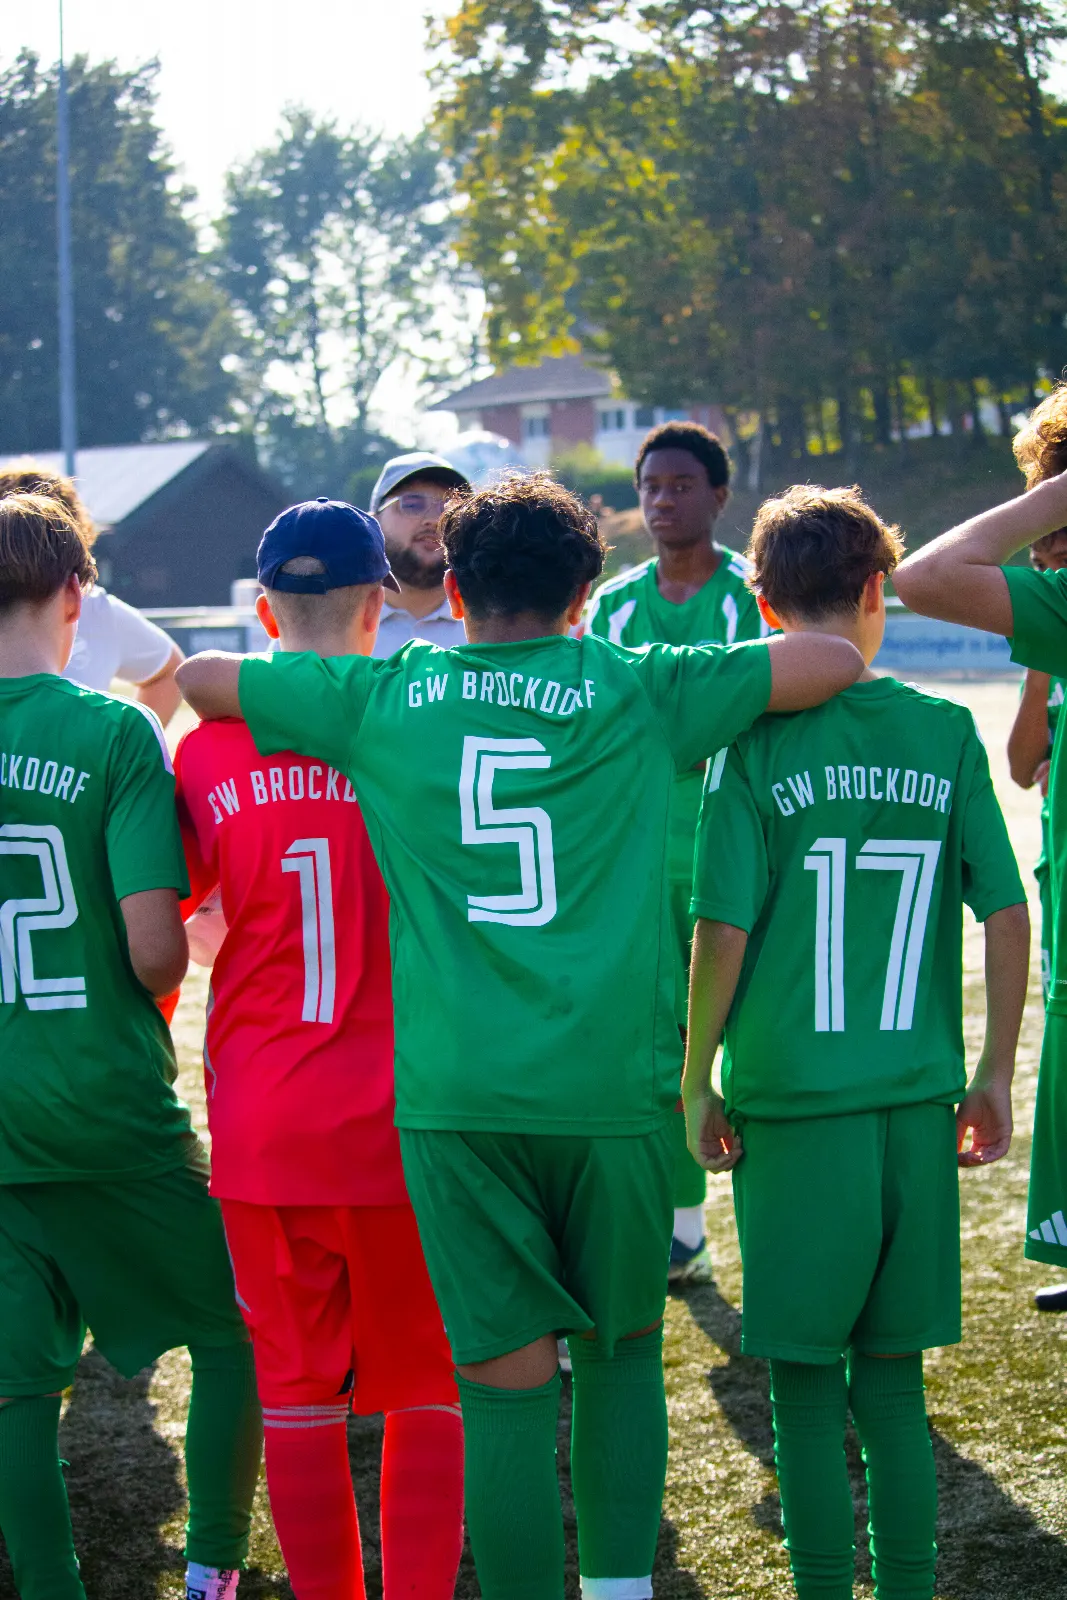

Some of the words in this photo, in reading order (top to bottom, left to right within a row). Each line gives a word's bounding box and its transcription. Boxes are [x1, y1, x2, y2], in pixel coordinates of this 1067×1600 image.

[408, 673, 449, 708] GW
[458, 735, 558, 927] 5
[771, 770, 815, 817] GW
[824, 765, 952, 816] BROCKDOR
[280, 837, 337, 1025] 1
[803, 837, 943, 1032] 17
